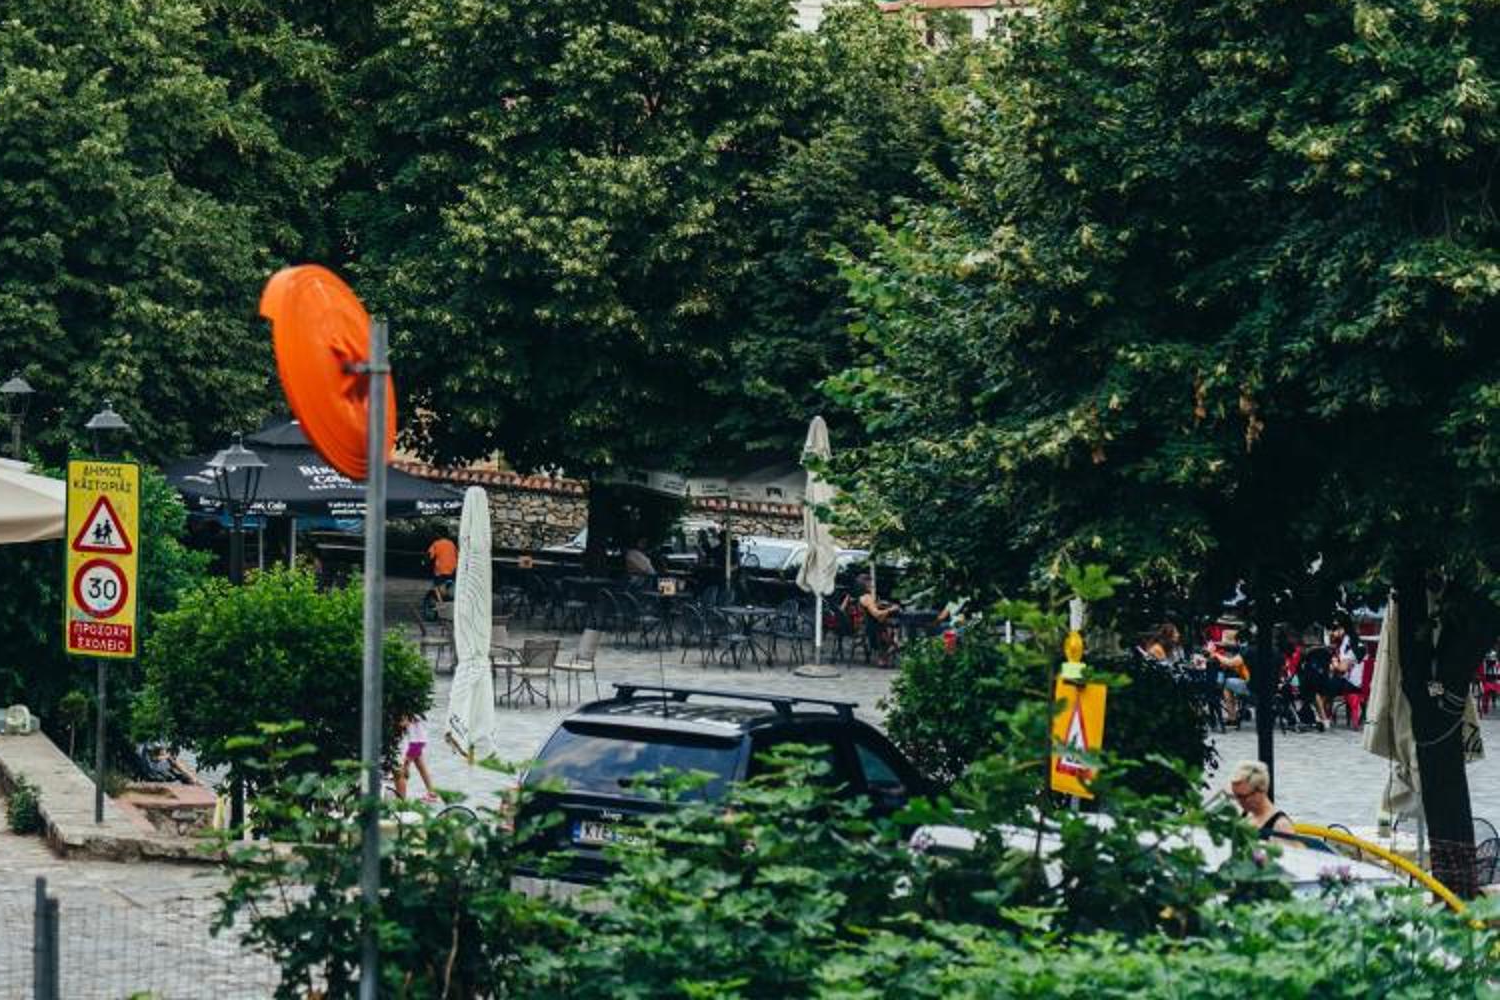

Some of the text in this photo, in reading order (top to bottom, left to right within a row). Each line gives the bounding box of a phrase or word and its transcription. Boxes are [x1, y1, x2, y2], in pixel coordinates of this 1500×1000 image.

[88, 577, 117, 601] 30
[73, 622, 129, 637] ΠΡΟΣΟΧΗ
[76, 636, 127, 651] ΣΧΟΛΕΙΟ
